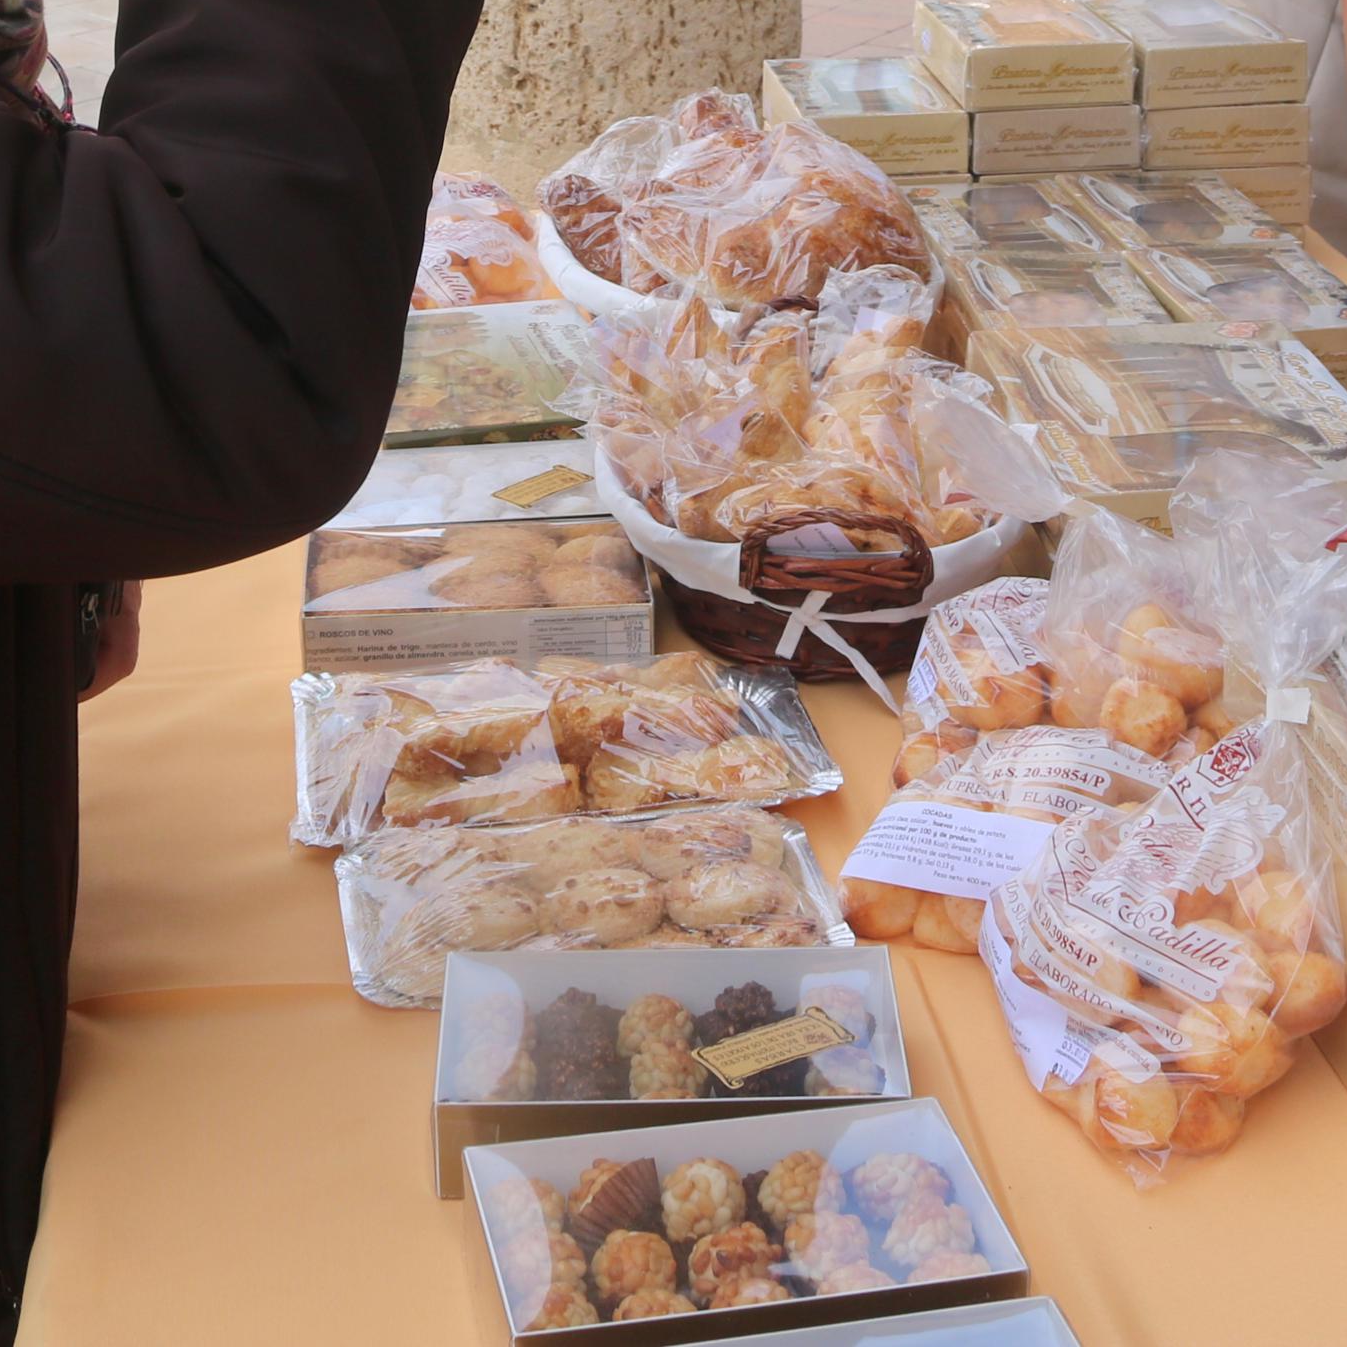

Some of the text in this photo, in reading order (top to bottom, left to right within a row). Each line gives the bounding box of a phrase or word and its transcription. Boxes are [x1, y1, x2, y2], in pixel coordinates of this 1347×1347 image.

[319, 630, 356, 638] ROSCOS
[1024, 767, 1106, 788] 20.39854/P
[919, 828, 932, 836] 100
[949, 834, 977, 844] producto
[966, 876, 980, 886] 400
[1040, 913, 1098, 967] 20.39854/P
[1118, 891, 1230, 972] Padilla
